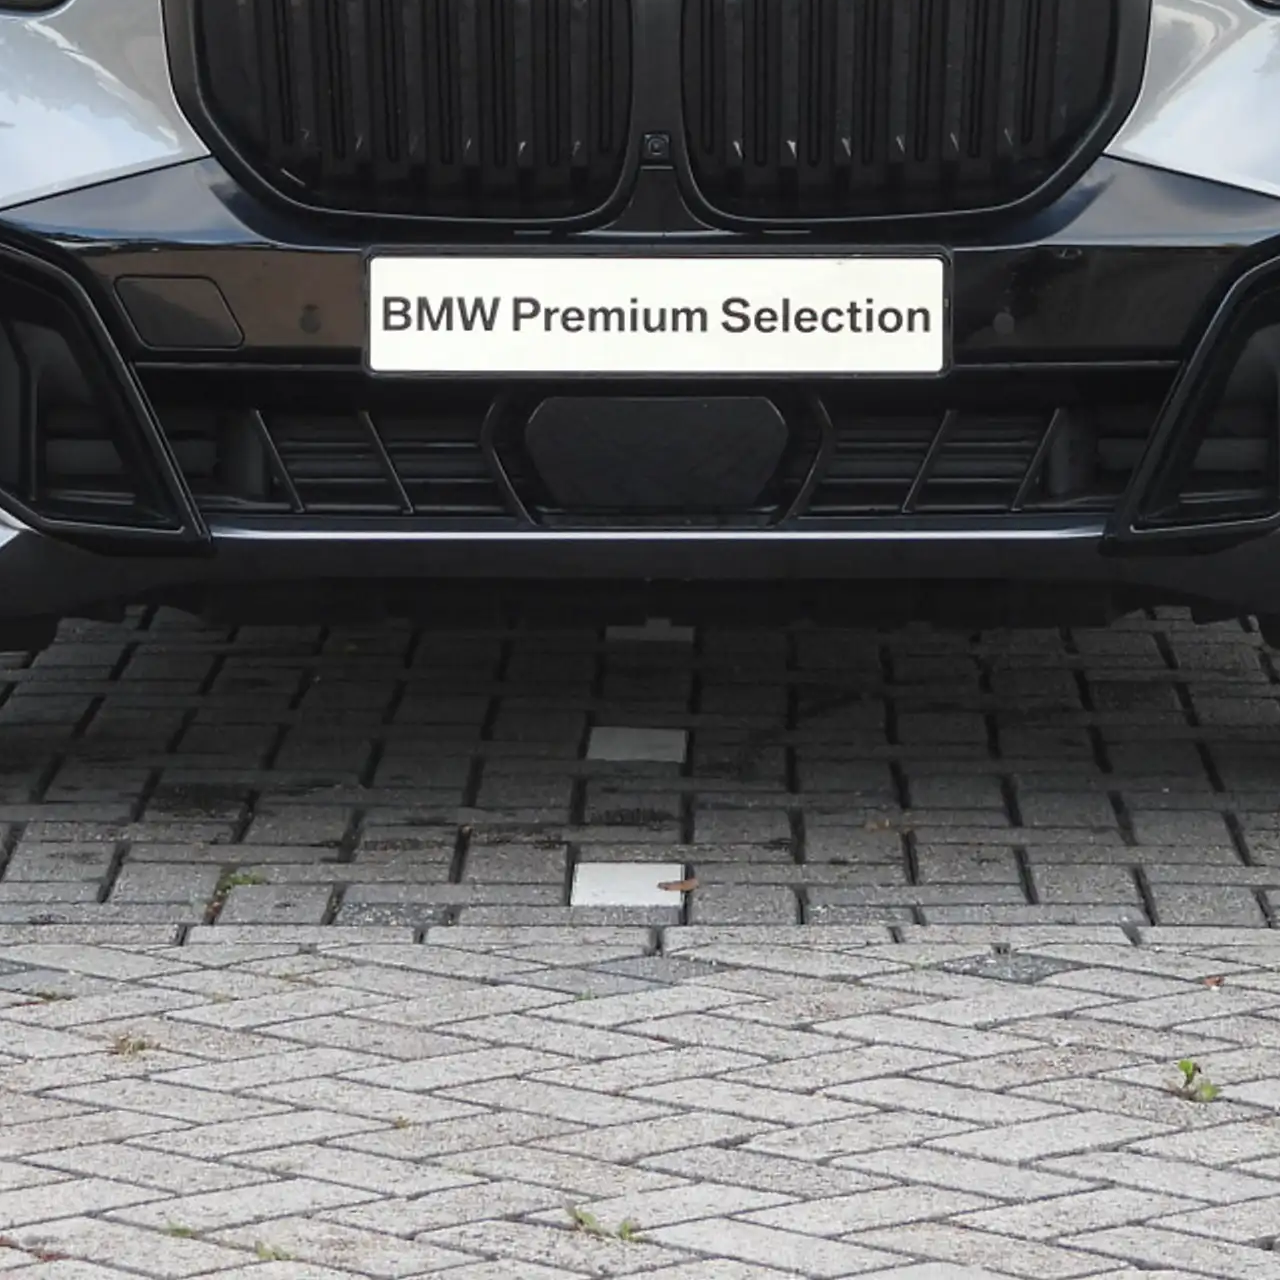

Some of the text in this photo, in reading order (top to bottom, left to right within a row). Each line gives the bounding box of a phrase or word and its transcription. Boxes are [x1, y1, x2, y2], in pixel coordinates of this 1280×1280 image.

[382, 296, 931, 333] BMW Premium Selection
